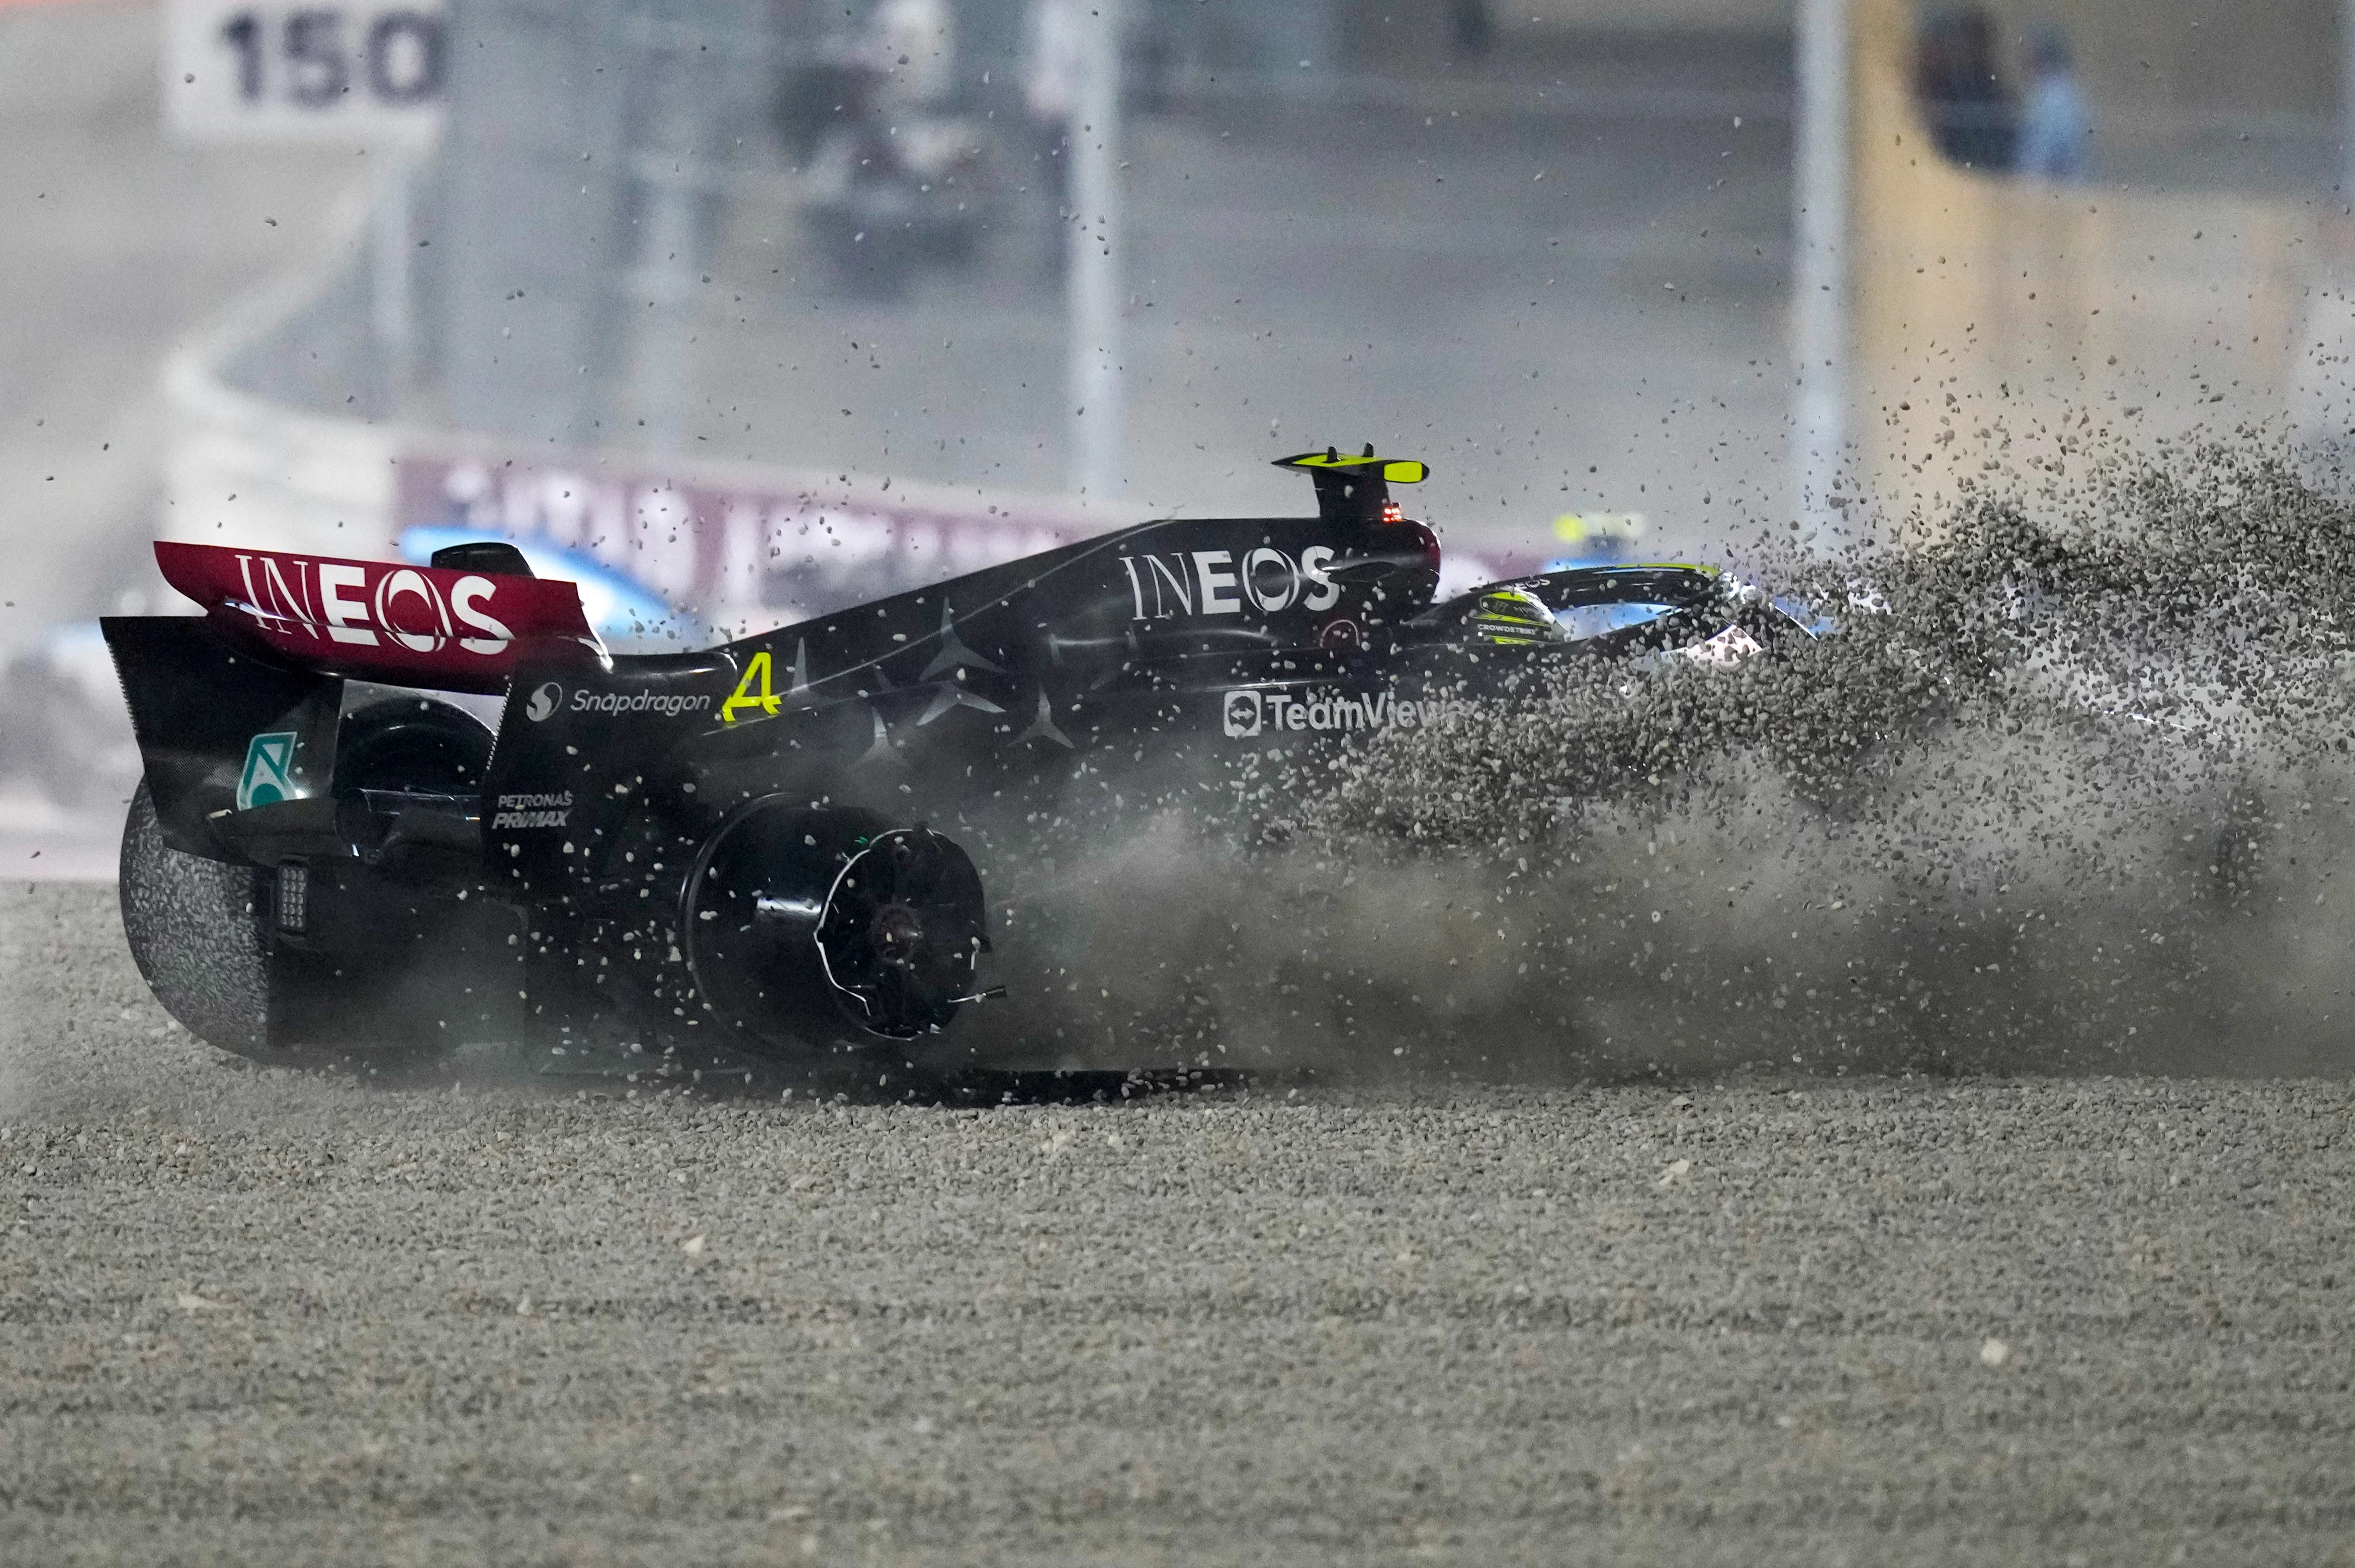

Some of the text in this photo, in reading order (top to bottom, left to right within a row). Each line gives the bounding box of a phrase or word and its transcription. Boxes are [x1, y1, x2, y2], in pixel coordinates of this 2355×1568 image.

[217, 11, 445, 107] 150
[234, 555, 515, 655] INEOS
[1118, 545, 1339, 620] INEOS
[570, 689, 711, 716] Snapdragon
[722, 652, 782, 721] 4
[491, 810, 570, 829] PRIMAX
[498, 790, 574, 808] PETRONAS
